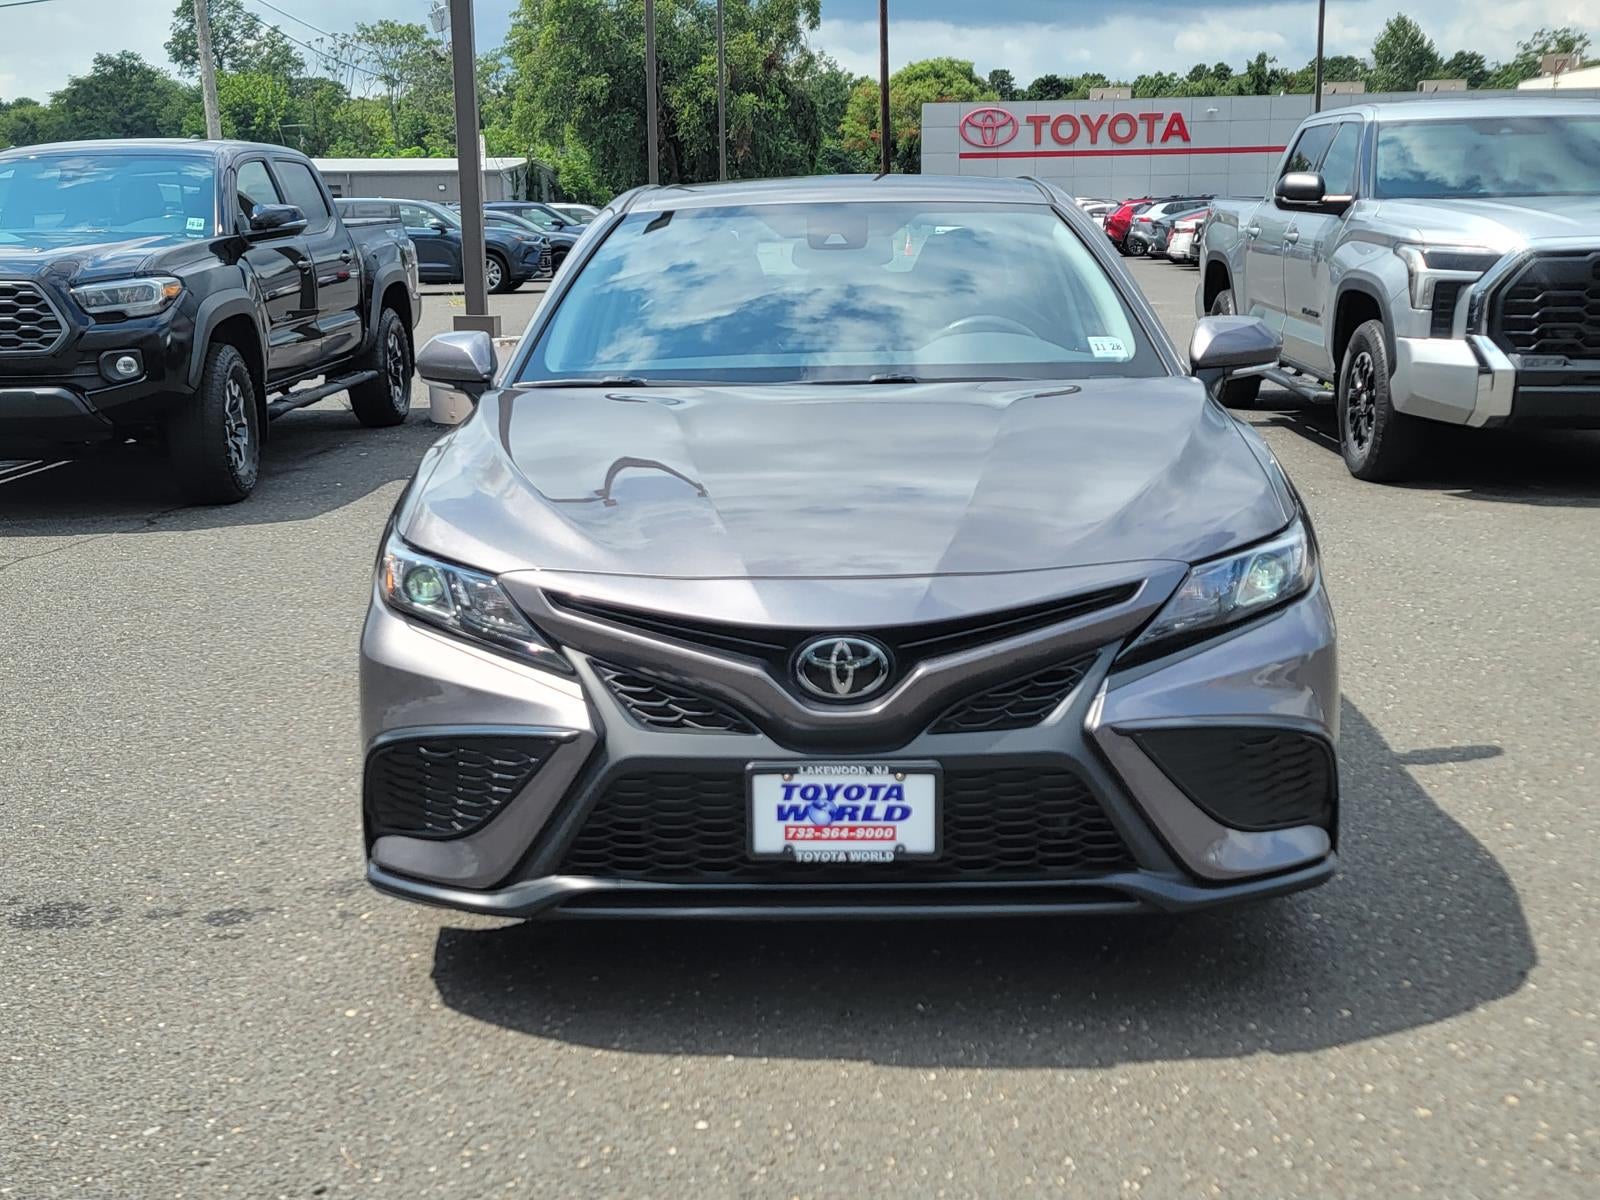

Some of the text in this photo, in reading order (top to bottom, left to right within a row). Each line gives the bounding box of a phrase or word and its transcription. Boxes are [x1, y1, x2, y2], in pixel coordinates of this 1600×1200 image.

[1026, 112, 1191, 145] TOYOTA
[799, 766, 889, 776] LAKEWOOD, NJ
[780, 783, 905, 801] TOYOTA
[777, 804, 913, 822] WORLD
[786, 827, 894, 840] 732-364-9000
[796, 850, 895, 863] TOYOTA WORLD
